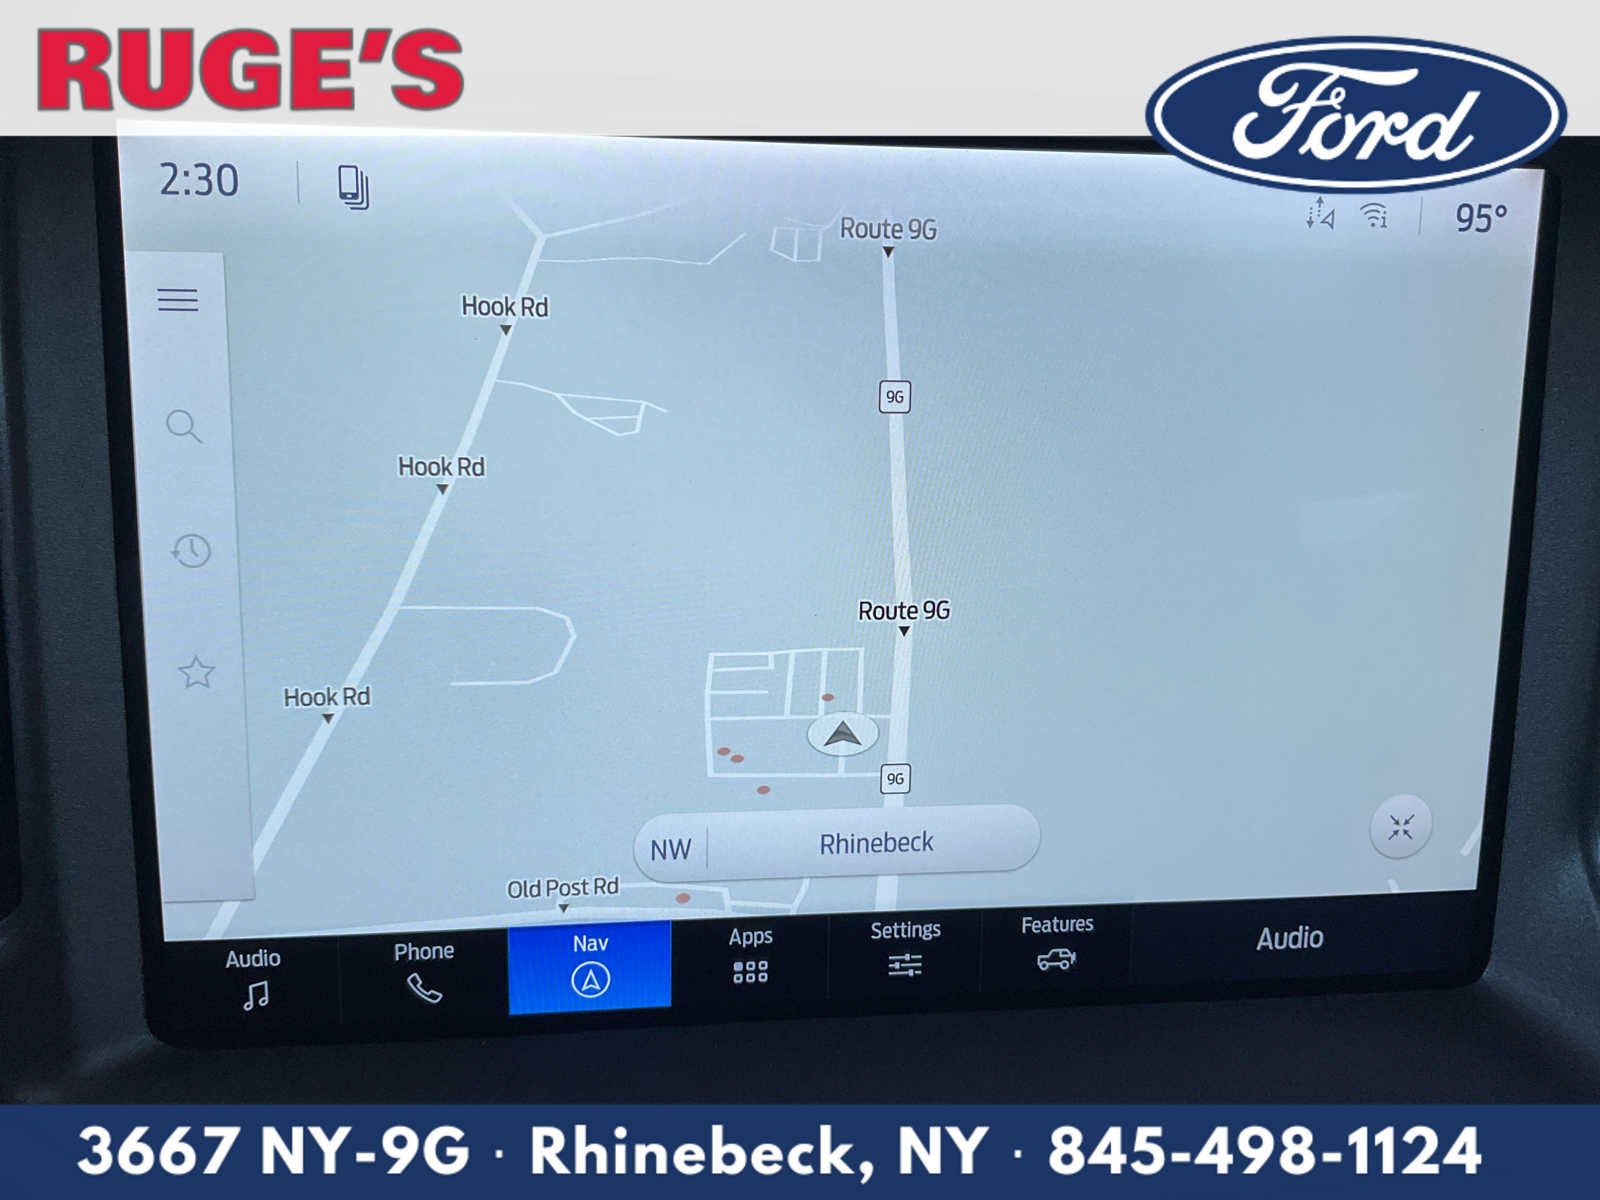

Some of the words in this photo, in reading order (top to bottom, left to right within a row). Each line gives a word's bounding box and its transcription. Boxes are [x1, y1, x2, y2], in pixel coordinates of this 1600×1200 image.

[159, 162, 240, 198] 2:30
[840, 216, 903, 240] Route
[909, 219, 937, 241] 9G
[1455, 204, 1508, 234] 95°
[461, 295, 516, 319] Hook
[521, 296, 549, 319] Rd
[886, 389, 905, 405] 9G
[398, 456, 453, 479] Hook
[457, 456, 486, 478] Rd
[858, 599, 918, 622] Route
[922, 599, 951, 622] 9G
[283, 686, 338, 709] Hook
[342, 686, 371, 708] Rd
[886, 771, 905, 787] 9G
[650, 837, 692, 862] NW
[820, 830, 935, 856] Rhinebeck
[507, 878, 541, 900] Old
[546, 877, 588, 899] Post
[593, 876, 620, 897] Rd
[870, 920, 942, 944] Settings
[1021, 914, 1095, 936] Features
[573, 935, 609, 954] Nav
[729, 927, 773, 950] Apps
[1256, 925, 1325, 953] Audio
[225, 949, 281, 970] Audio
[394, 940, 455, 962] Phone
